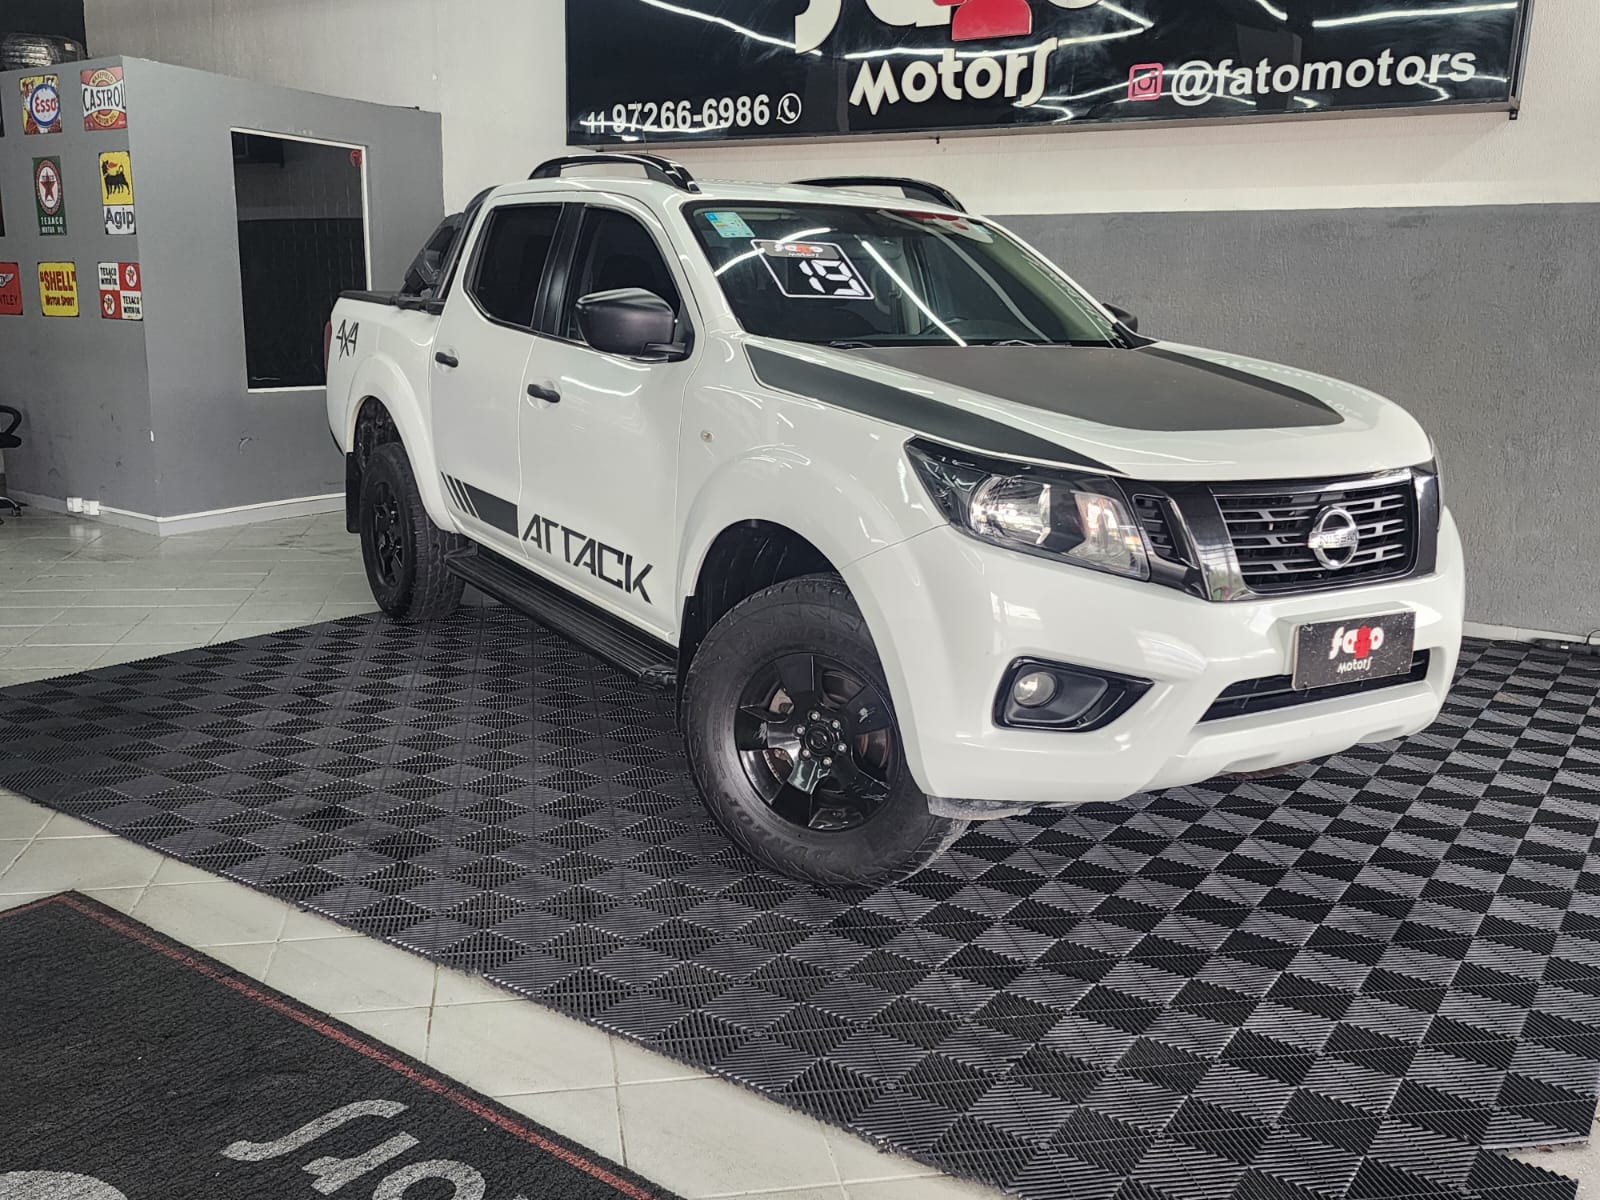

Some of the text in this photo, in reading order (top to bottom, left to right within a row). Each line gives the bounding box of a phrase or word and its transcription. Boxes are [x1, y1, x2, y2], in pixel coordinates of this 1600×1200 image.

[849, 37, 1059, 116] Motors
[1170, 47, 1477, 106] @fatomotors
[82, 83, 126, 112] CASTROL
[611, 93, 770, 133] 97266-6986
[40, 216, 64, 225] TEXACO
[104, 207, 134, 230] Agip
[100, 267, 117, 277] TEXACO
[123, 296, 140, 305] TEXACO
[522, 513, 654, 605] ATTACK
[1337, 656, 1374, 674] Motors
